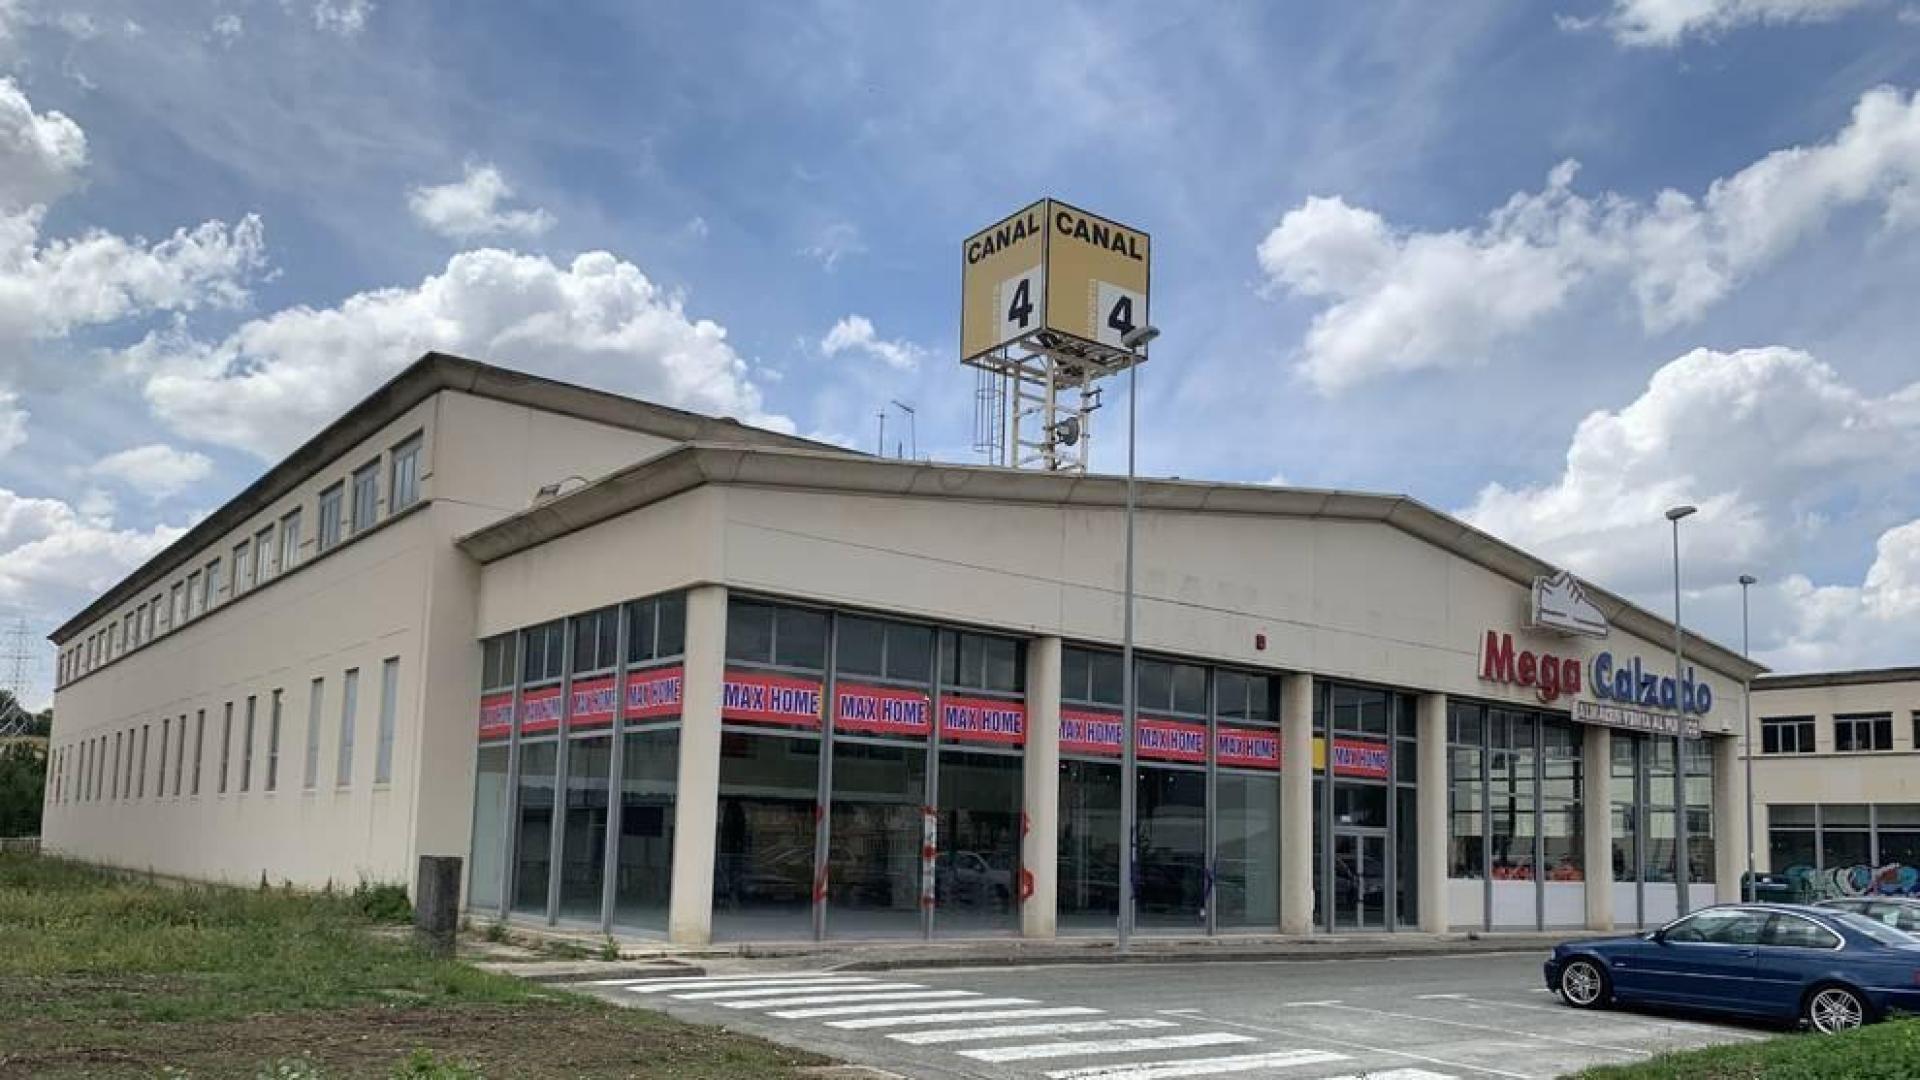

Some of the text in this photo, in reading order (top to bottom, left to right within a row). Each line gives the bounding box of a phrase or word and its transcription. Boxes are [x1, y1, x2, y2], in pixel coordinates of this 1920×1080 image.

[967, 213, 1040, 264] CANAL
[1056, 212, 1143, 261] CANAL
[1008, 278, 1034, 328] 4
[1108, 295, 1136, 339] 4
[1479, 629, 1712, 715] Mega Calzado
[651, 677, 681, 706] HOME
[723, 682, 820, 715] MAX HOME
[840, 694, 926, 724] MAX HOME
[945, 706, 1022, 735] MAX HOME
[1086, 721, 1123, 745] HOME
[1139, 727, 1204, 752] MAX HOME
[1218, 734, 1276, 760] MAX HOME
[1335, 746, 1388, 770] MAX HOME
